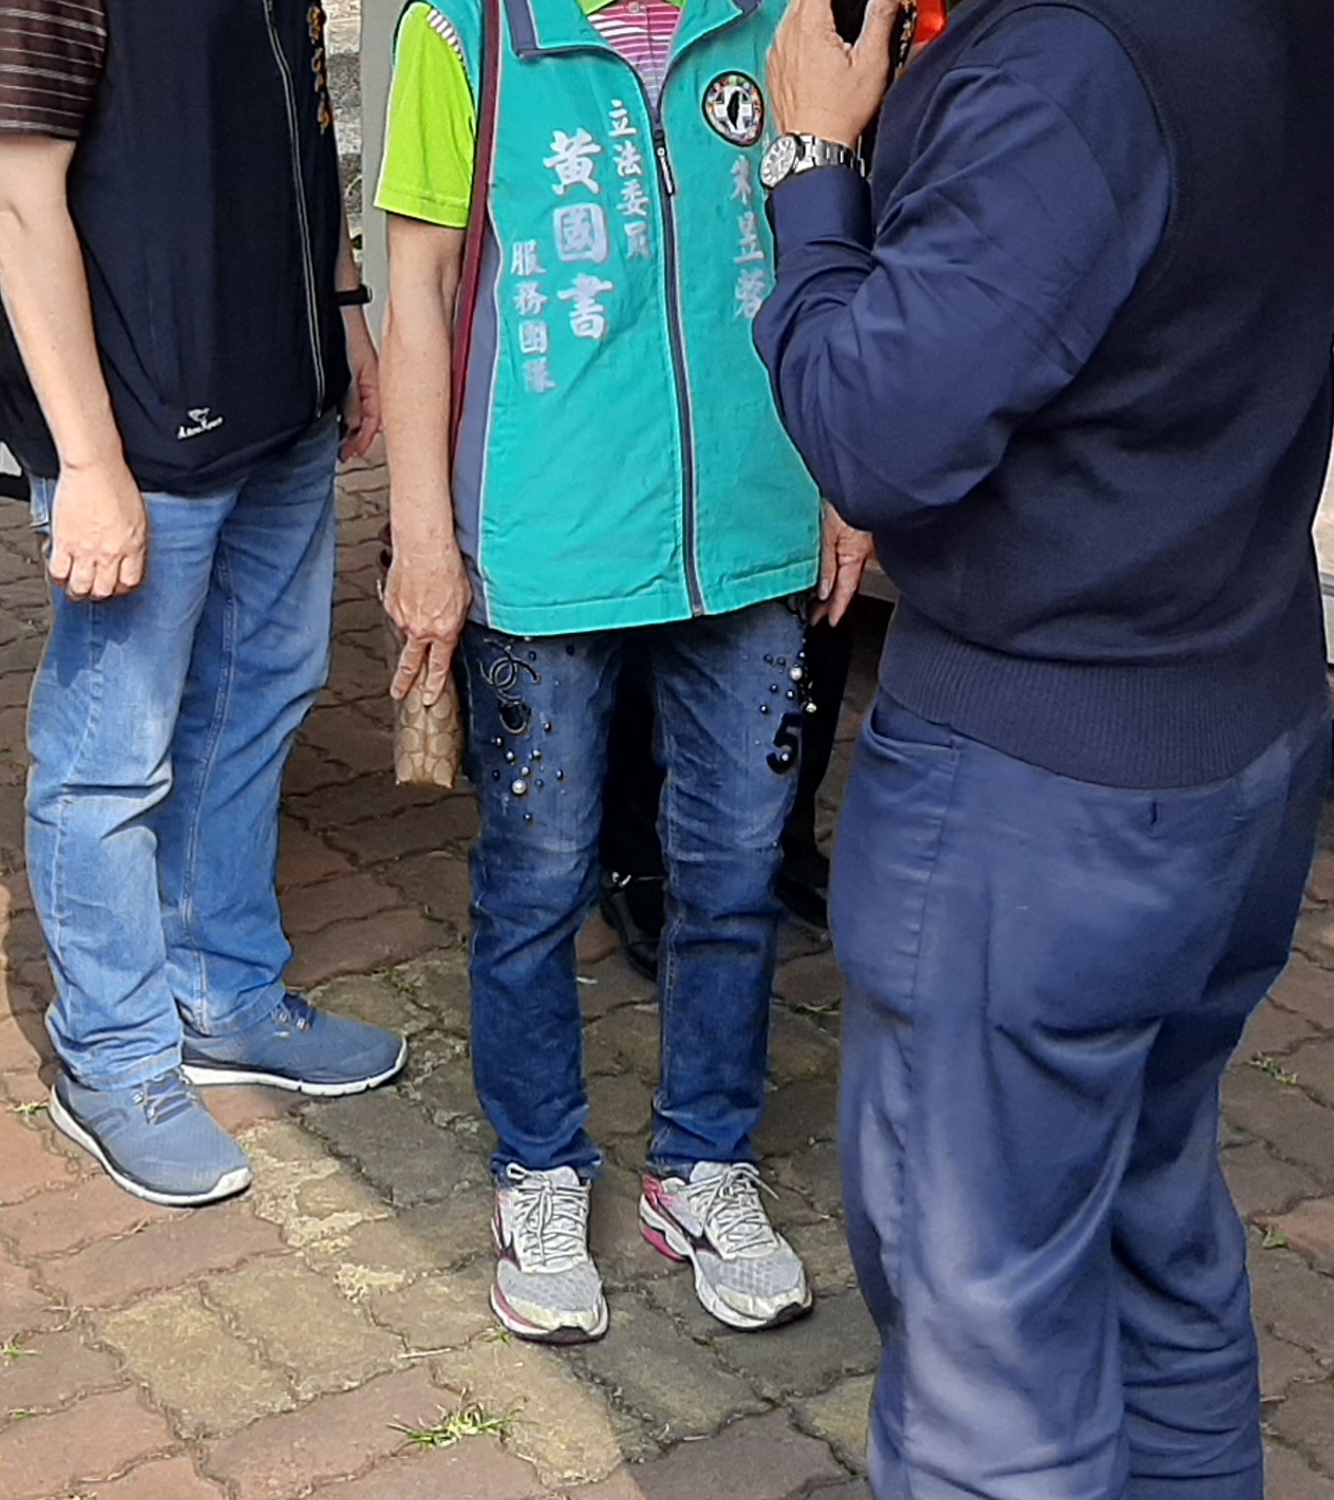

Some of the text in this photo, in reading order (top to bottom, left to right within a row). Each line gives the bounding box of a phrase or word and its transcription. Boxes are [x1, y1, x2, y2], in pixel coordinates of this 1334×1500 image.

[543, 127, 614, 339] 黃國書
[608, 100, 652, 260] 立法委員
[510, 239, 555, 394] 服務團隊
